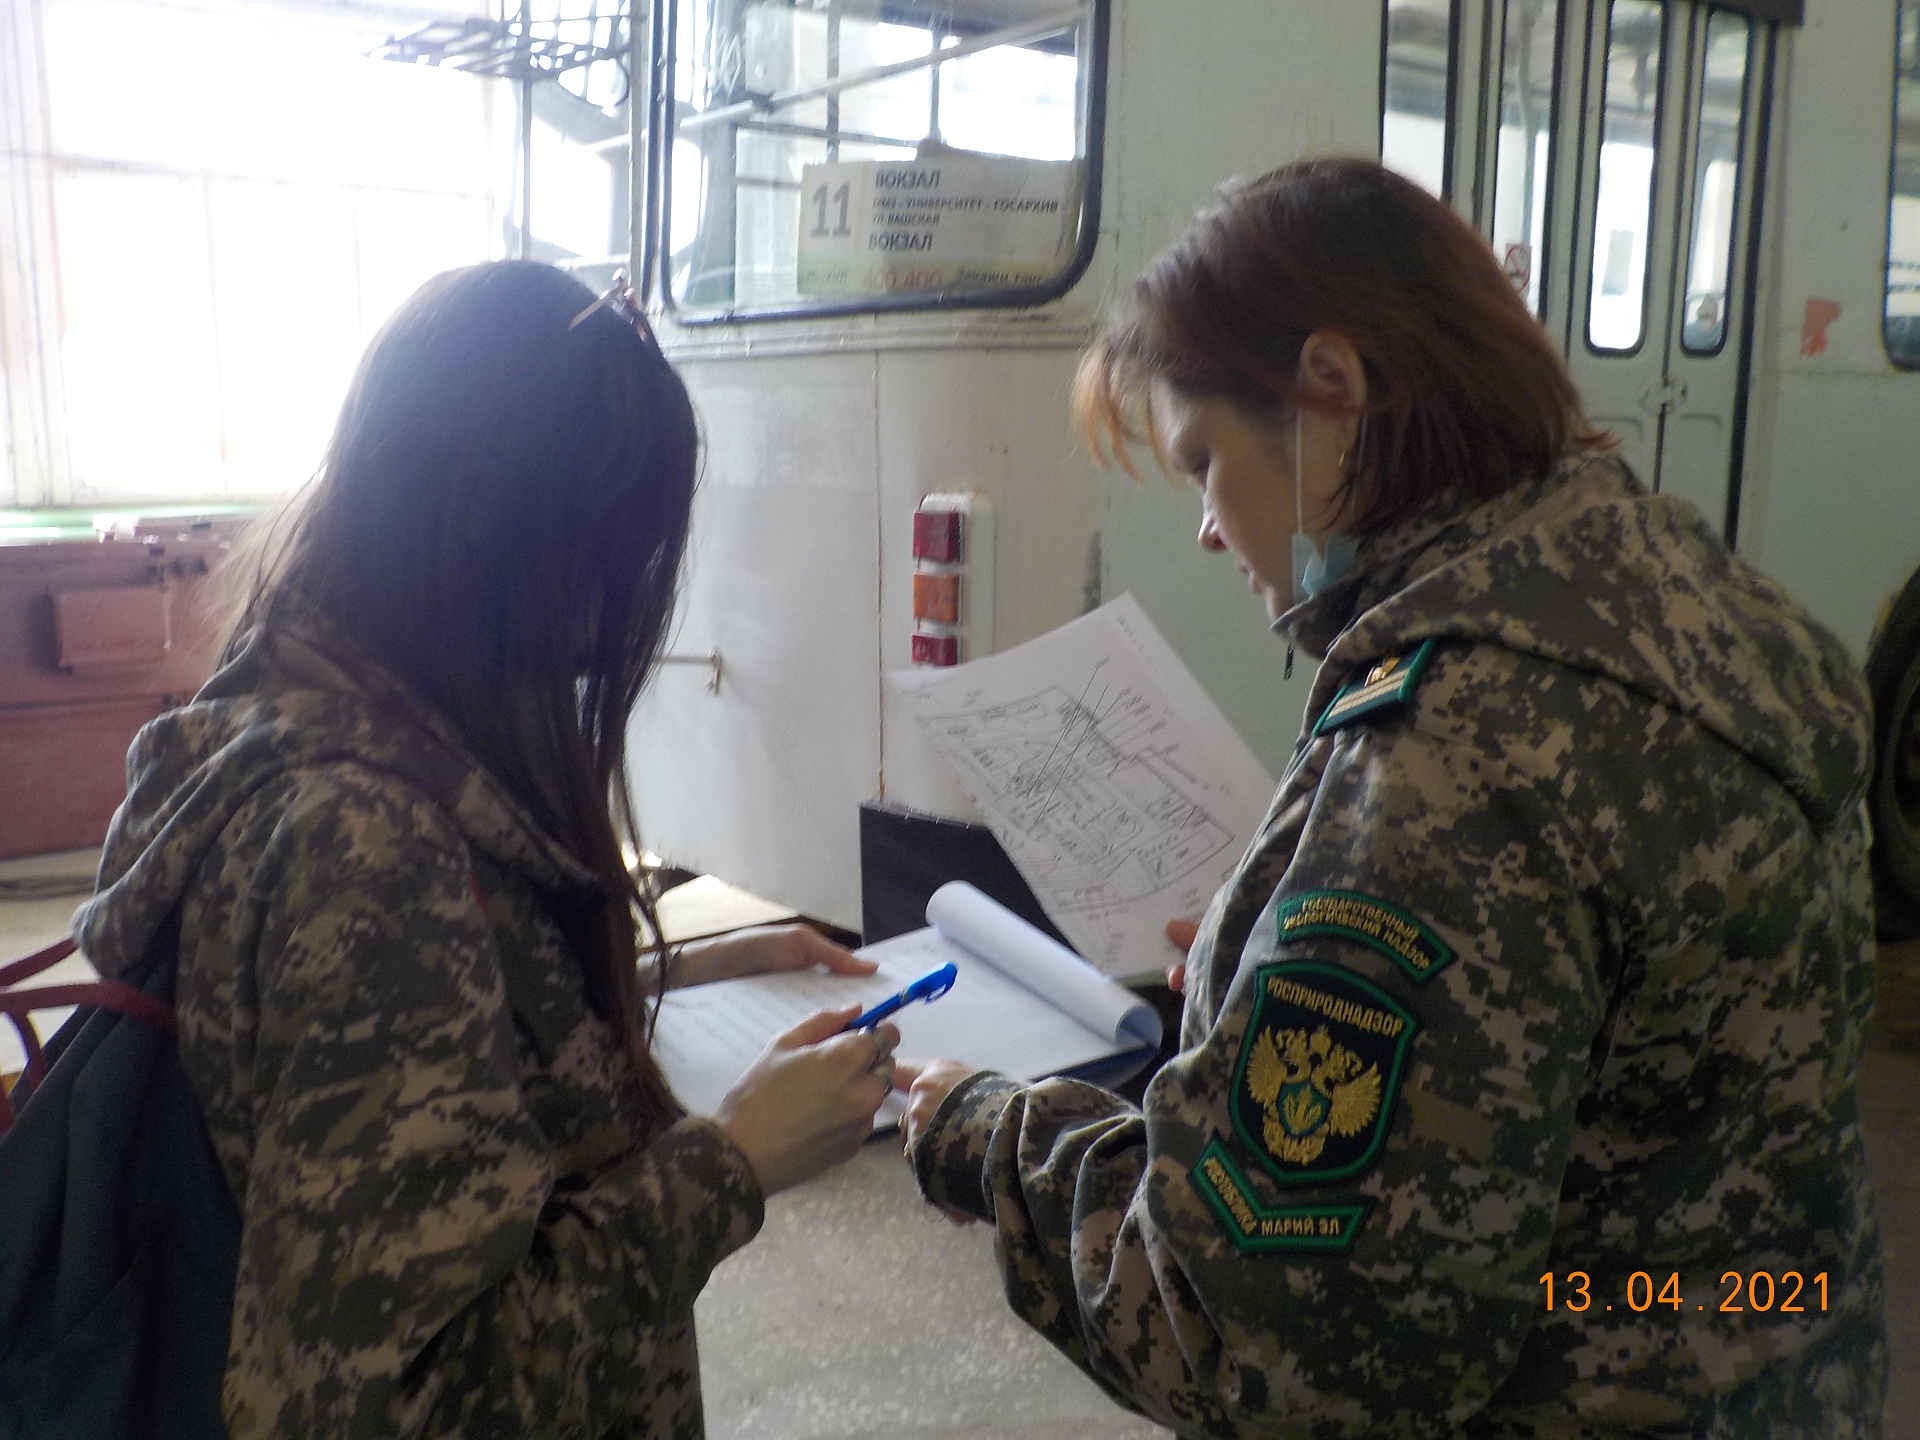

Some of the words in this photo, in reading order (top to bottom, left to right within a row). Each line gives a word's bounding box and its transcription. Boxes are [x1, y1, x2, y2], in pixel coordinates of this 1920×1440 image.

[874, 168, 941, 189] ВОКЗАЛ
[811, 182, 851, 236] 11
[905, 198, 983, 213] УНИВЕРСИТЕТ
[993, 199, 1060, 214] ГОСАРХИВ
[868, 231, 933, 252] ВОКЗАЛ
[863, 267, 896, 289] 400
[904, 268, 943, 289] 400
[1382, 928, 1431, 970] НАДЗОР
[1267, 976, 1403, 1038] РОСПРИРОДНАДЗОР
[1261, 1215, 1314, 1236] МАРИЙ
[1318, 1216, 1340, 1236] ЭЛ
